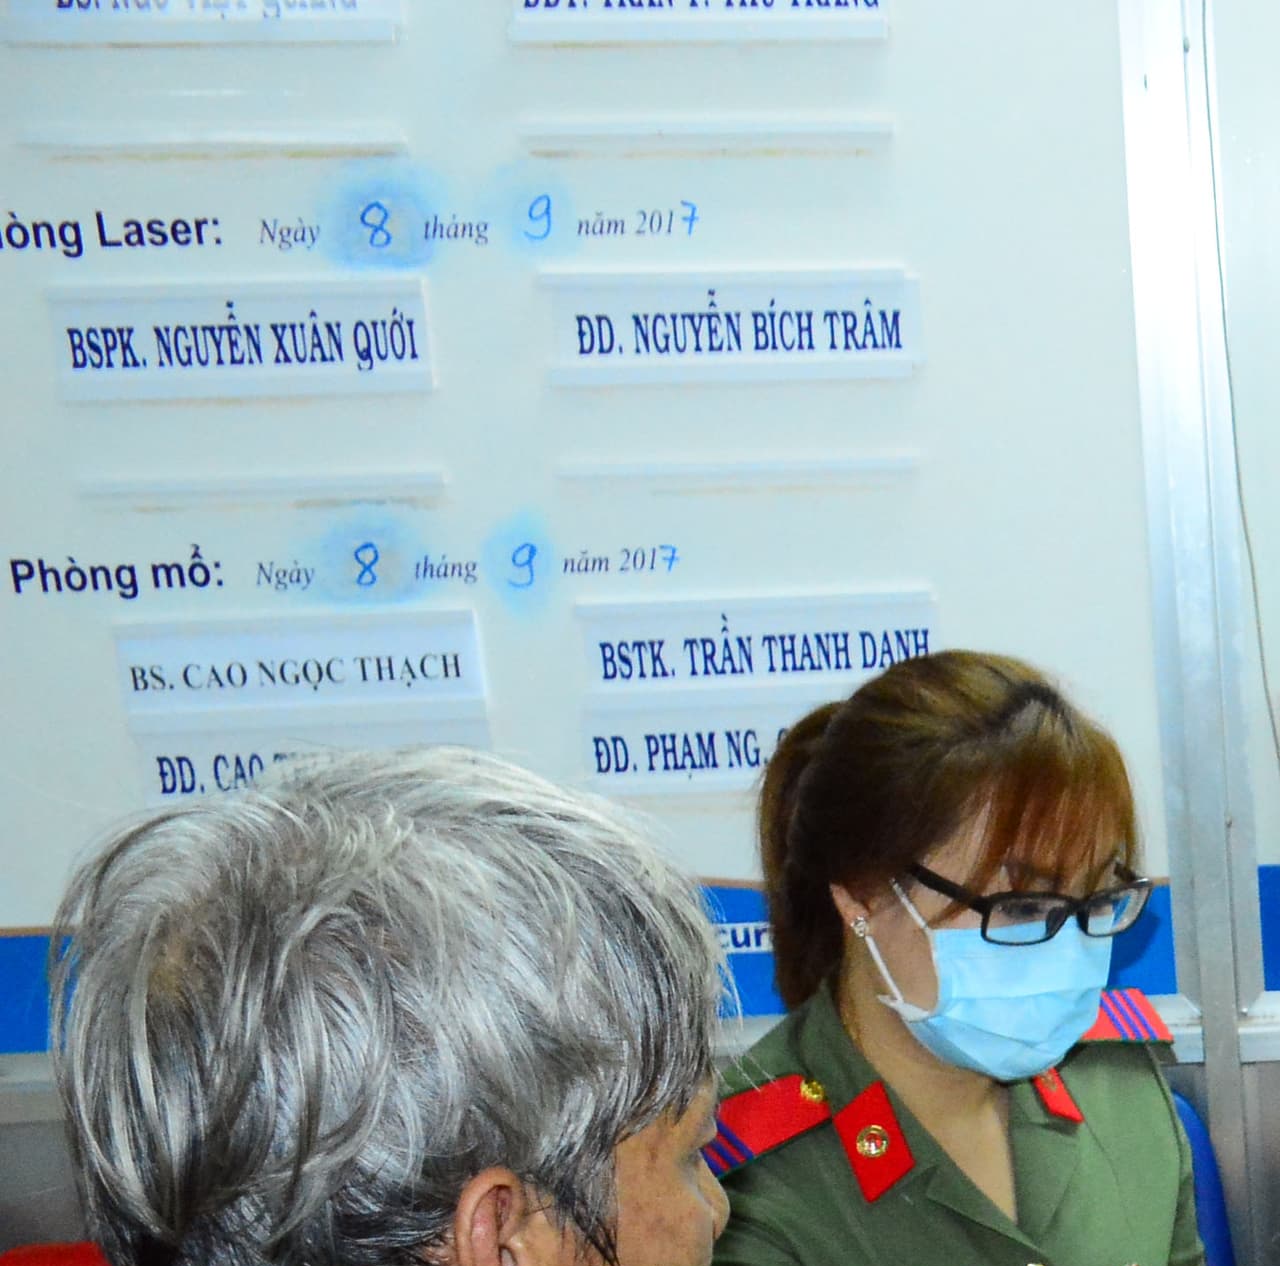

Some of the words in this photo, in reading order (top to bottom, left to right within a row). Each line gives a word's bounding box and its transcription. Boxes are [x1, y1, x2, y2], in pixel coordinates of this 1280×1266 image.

[0, 211, 85, 258] òng
[95, 211, 223, 249] Laser:
[259, 217, 322, 247] Ngày
[359, 201, 393, 249] 8
[423, 213, 490, 246] tháng
[522, 194, 554, 241] 9
[577, 212, 626, 237] năm
[635, 200, 699, 237] 2017
[67, 325, 147, 370] BSPK.
[155, 301, 262, 368] NGUYỄN
[272, 309, 345, 365] XUÂN
[576, 313, 624, 356] ĐD.
[632, 289, 742, 355] NGUYỄN
[752, 300, 816, 352] BÍCH
[823, 298, 903, 351] TRÂM
[10, 556, 140, 600] Phòng
[151, 543, 225, 589] mổ:
[255, 558, 315, 592] Ngày
[353, 542, 380, 587] 8
[414, 554, 478, 585] tháng
[506, 542, 538, 589] 9
[562, 549, 611, 575] năm
[618, 544, 680, 575] 2017
[130, 666, 175, 693] BS.
[183, 662, 249, 690] CAO
[259, 658, 347, 692] NGỌC
[354, 653, 463, 687] THẠCH
[599, 639, 677, 680] BSTK.
[683, 614, 755, 678] TRẦN
[763, 631, 852, 675] THANH
[859, 627, 930, 672] DANH
[157, 755, 206, 795] ĐD.
[213, 754, 265, 792] CAO
[594, 736, 638, 775] ĐD.
[644, 731, 719, 780] PHẠM
[727, 729, 770, 770] NG.
